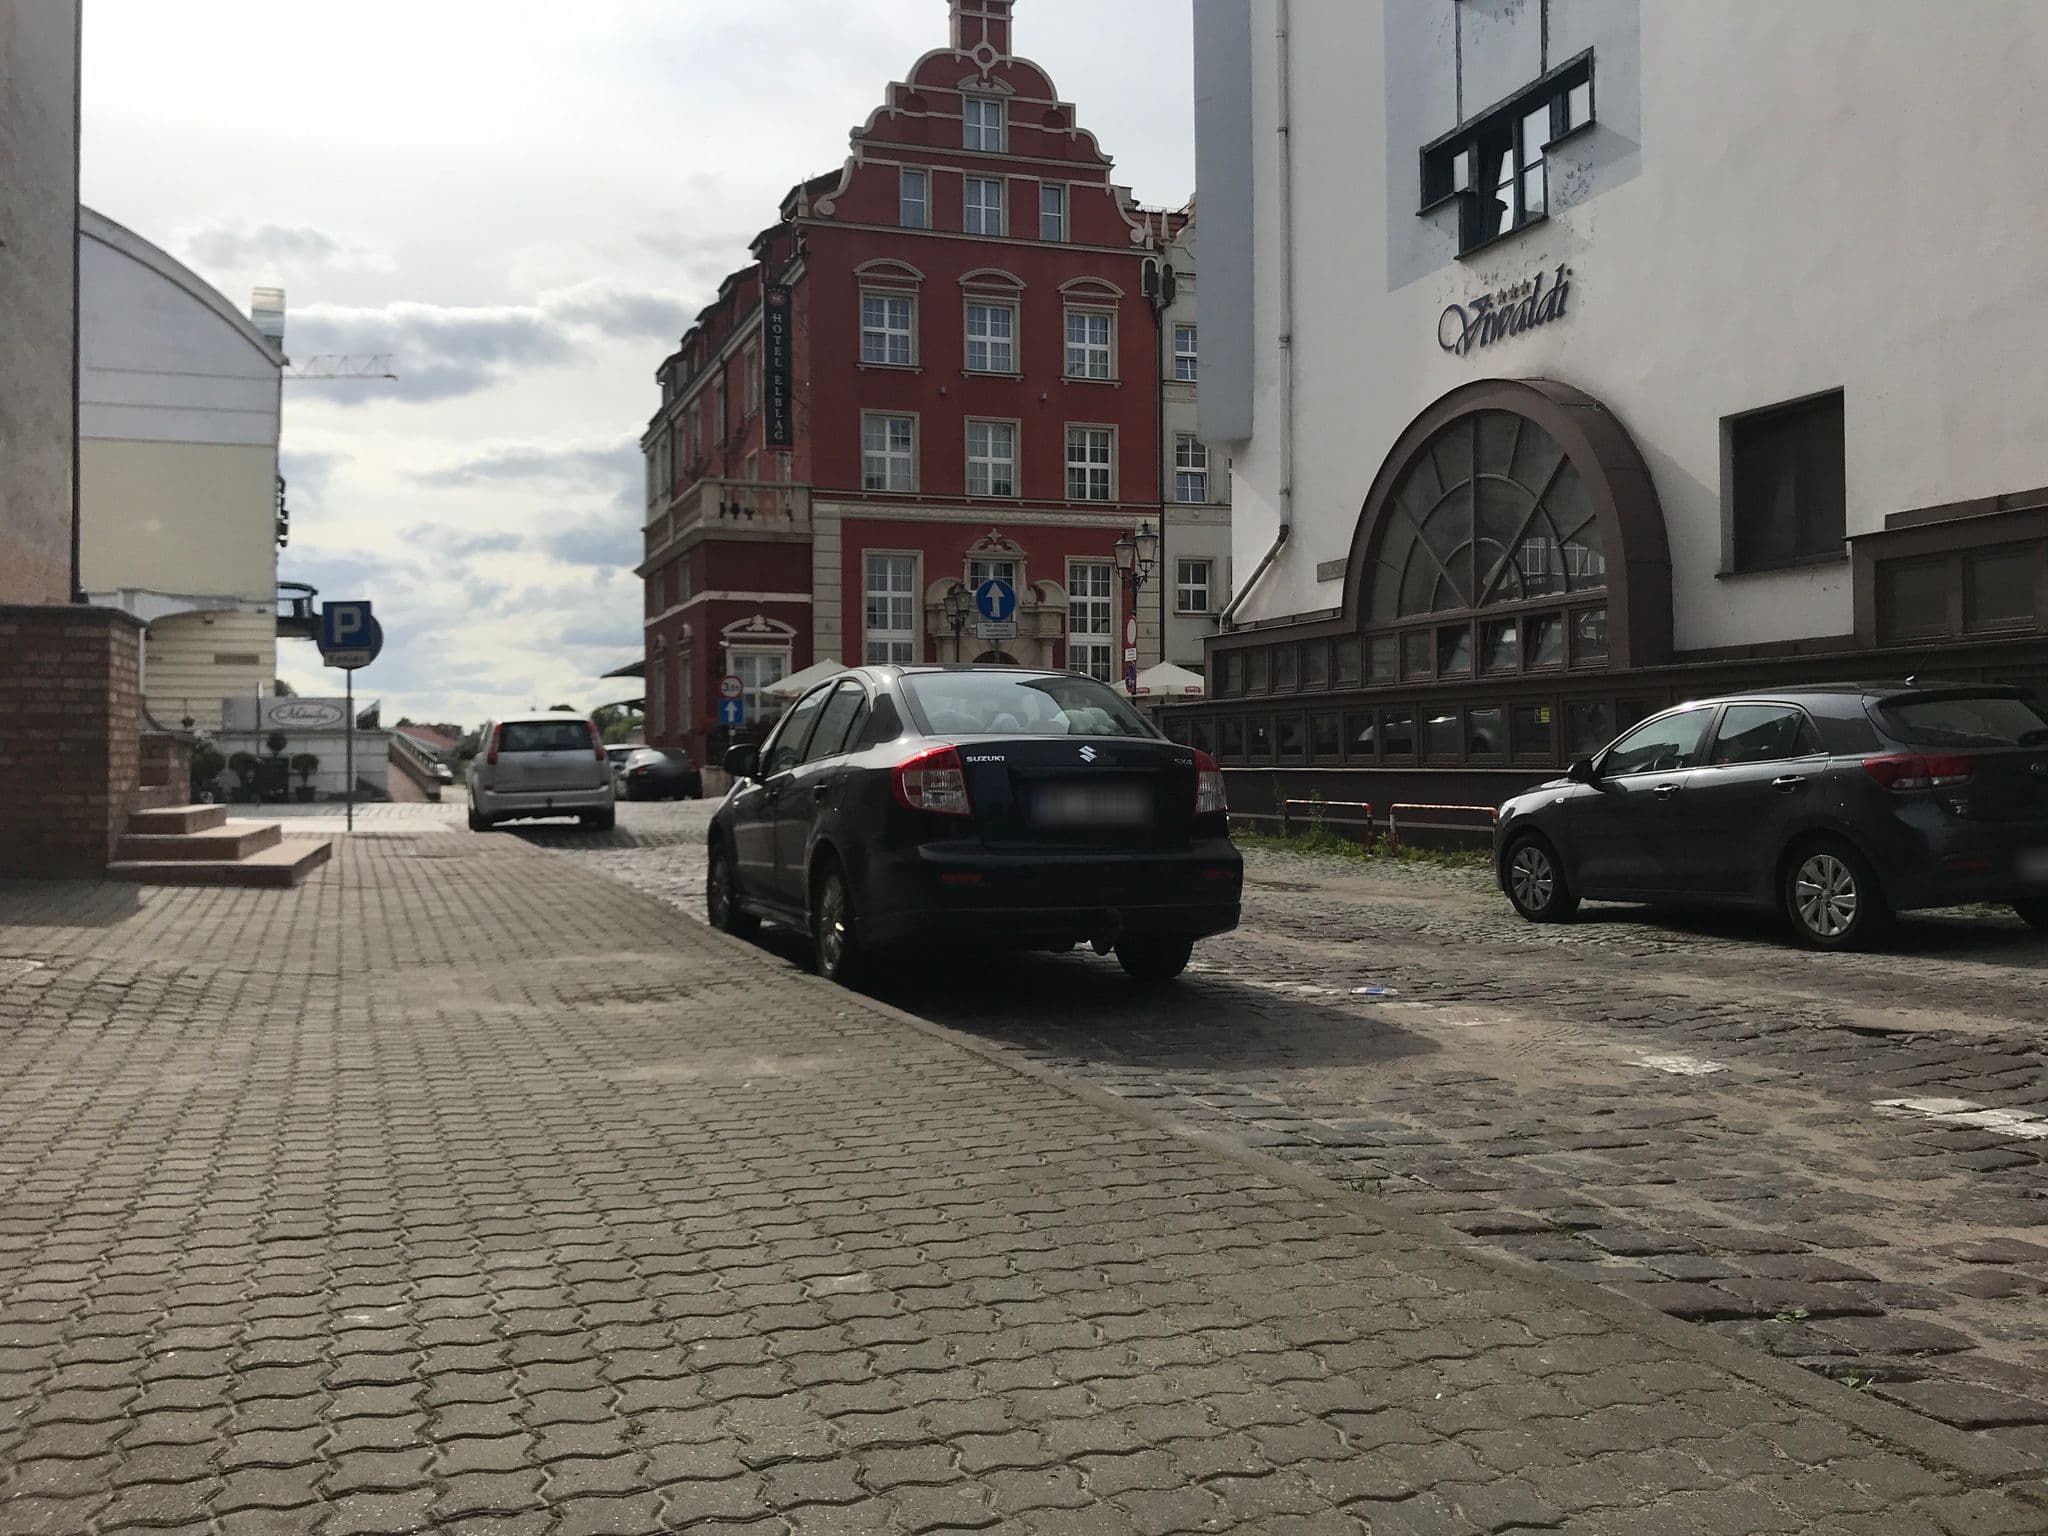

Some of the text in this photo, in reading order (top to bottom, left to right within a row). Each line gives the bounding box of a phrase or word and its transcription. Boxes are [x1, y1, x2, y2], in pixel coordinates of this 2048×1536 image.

[1438, 262, 1572, 356] Vivaldi
[771, 312, 783, 367] HOTEL
[334, 607, 361, 643] P
[966, 755, 1005, 763] SUZUKI
